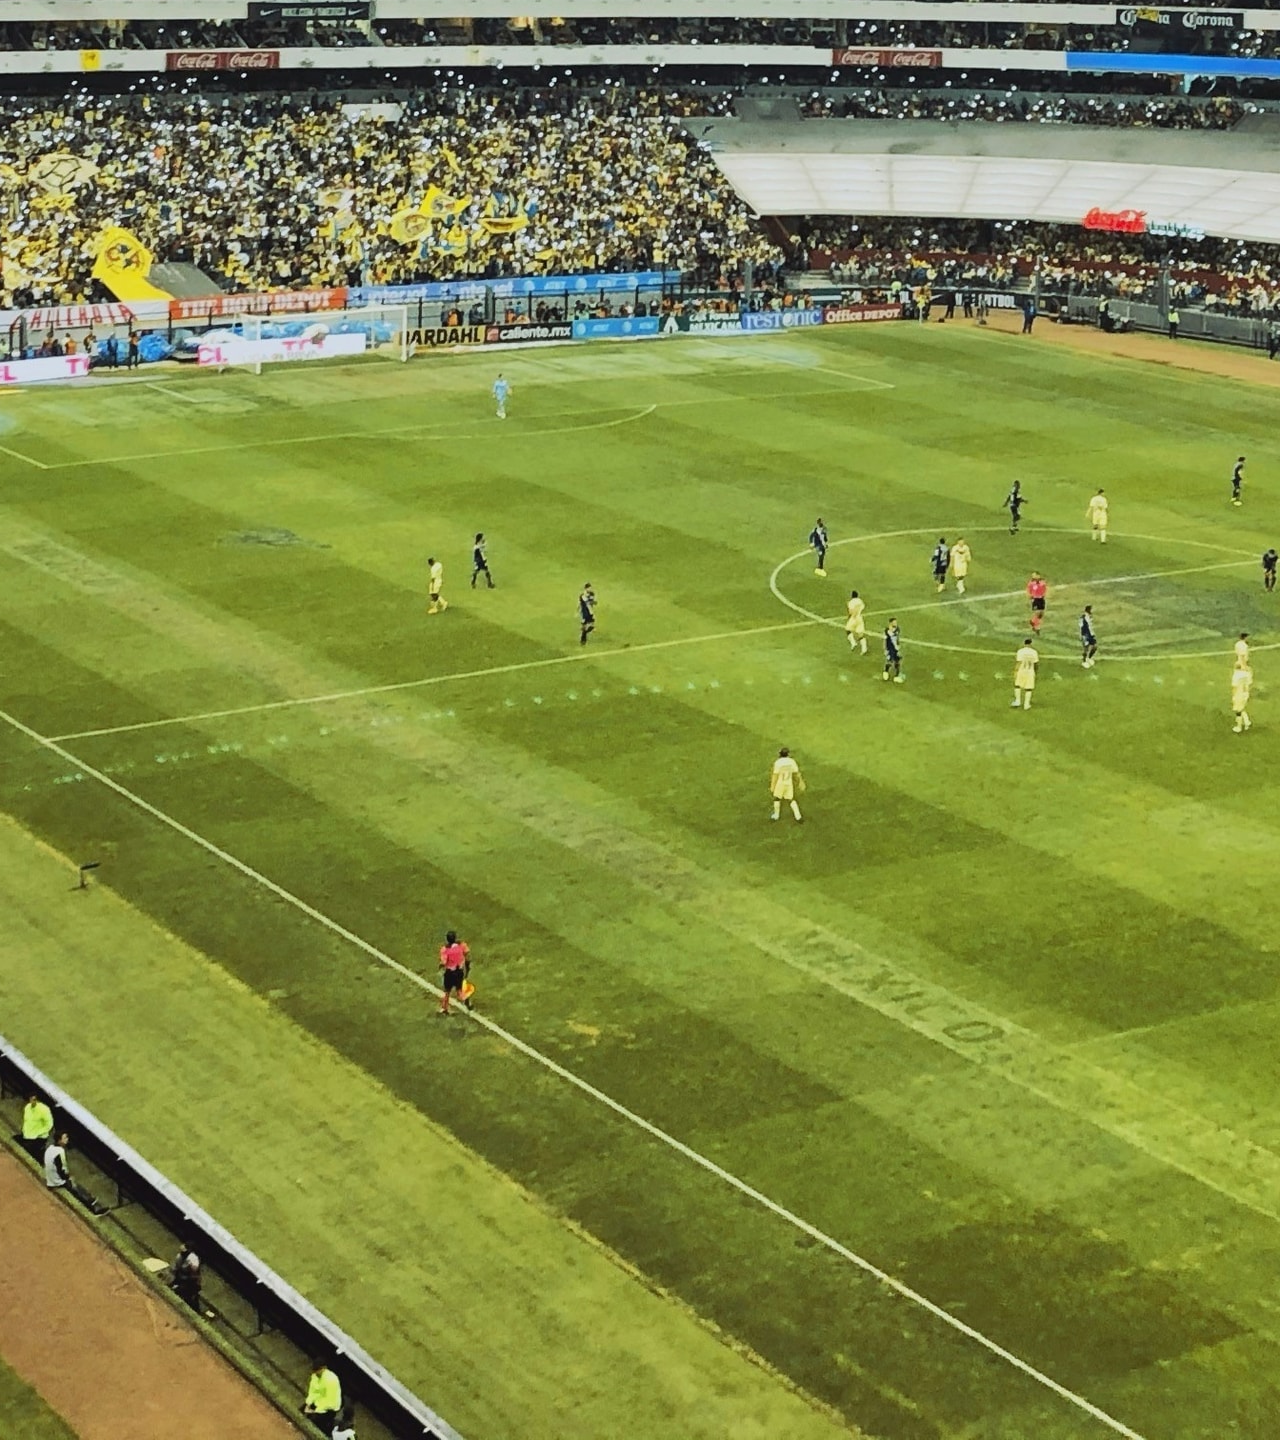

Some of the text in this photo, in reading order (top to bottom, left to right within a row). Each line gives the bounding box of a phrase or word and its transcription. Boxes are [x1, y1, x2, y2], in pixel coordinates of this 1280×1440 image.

[1182, 12, 1235, 30] Corona
[826, 309, 862, 324] Office
[499, 325, 572, 340] caliente.mx
